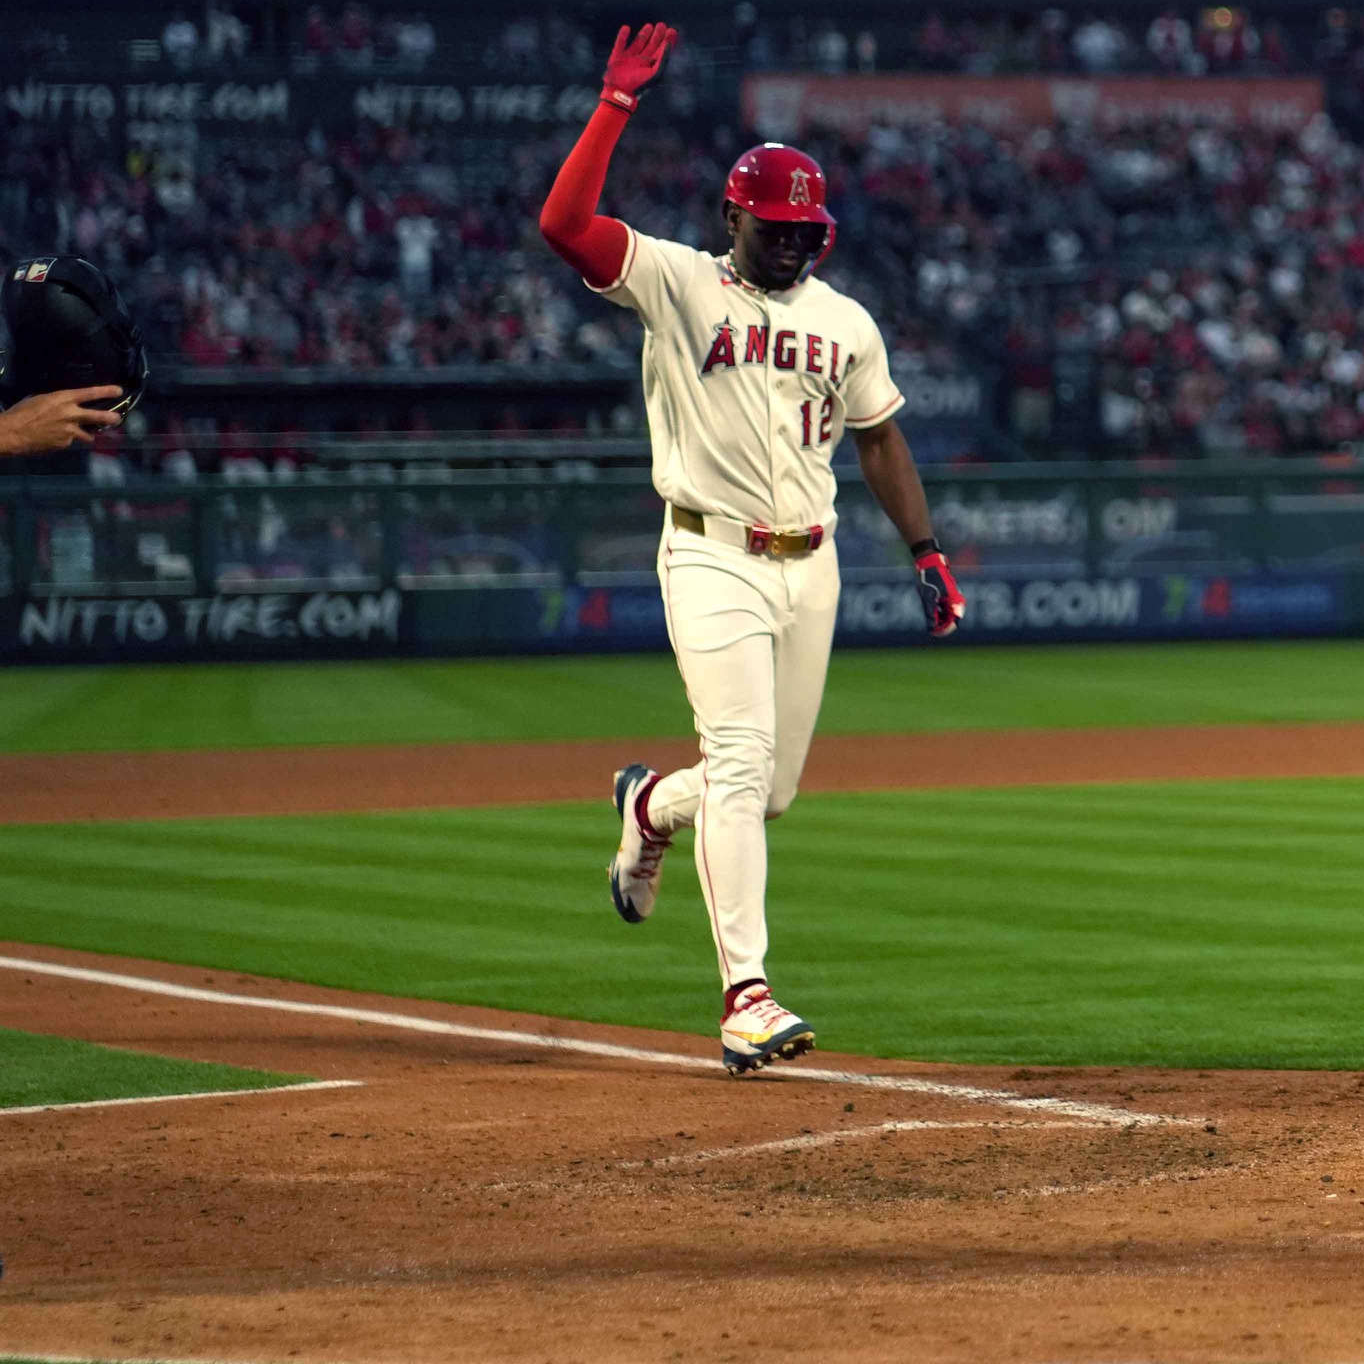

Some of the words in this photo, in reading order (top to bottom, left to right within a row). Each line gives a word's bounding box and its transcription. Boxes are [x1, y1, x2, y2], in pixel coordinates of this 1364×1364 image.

[788, 167, 812, 206] A
[799, 395, 835, 450] 12
[22, 594, 166, 644] NITTO
[180, 589, 399, 637] TIRE.COM
[841, 580, 1141, 629] ICKTS.COM
